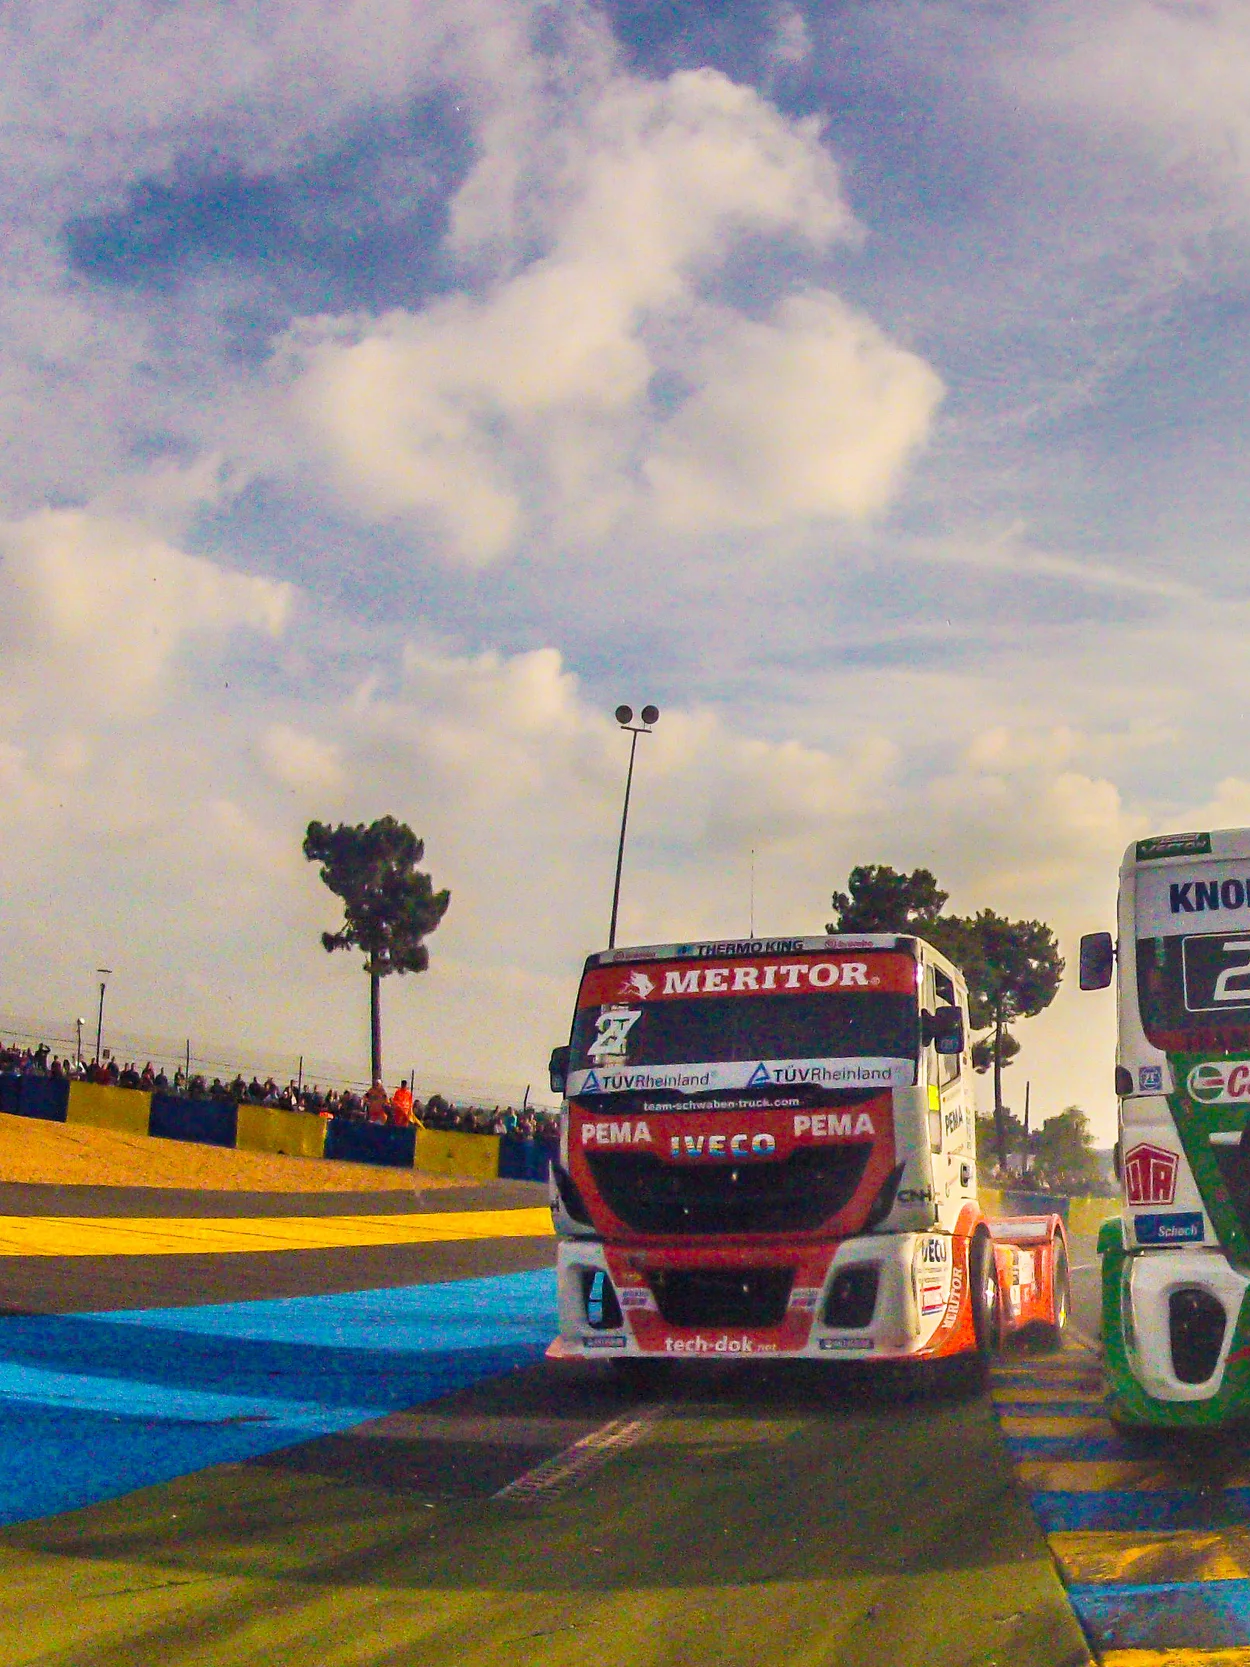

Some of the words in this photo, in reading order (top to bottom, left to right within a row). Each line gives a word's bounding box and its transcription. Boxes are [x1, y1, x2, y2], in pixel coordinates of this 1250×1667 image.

[698, 941, 763, 956] THERMO
[765, 940, 803, 953] KING
[662, 962, 869, 994] MERITOR
[581, 1121, 653, 1146] PEMA
[793, 1113, 876, 1137] PEMA
[944, 1105, 963, 1137] PEMA
[669, 1132, 776, 1158] IVECO
[920, 1239, 947, 1262] VECO
